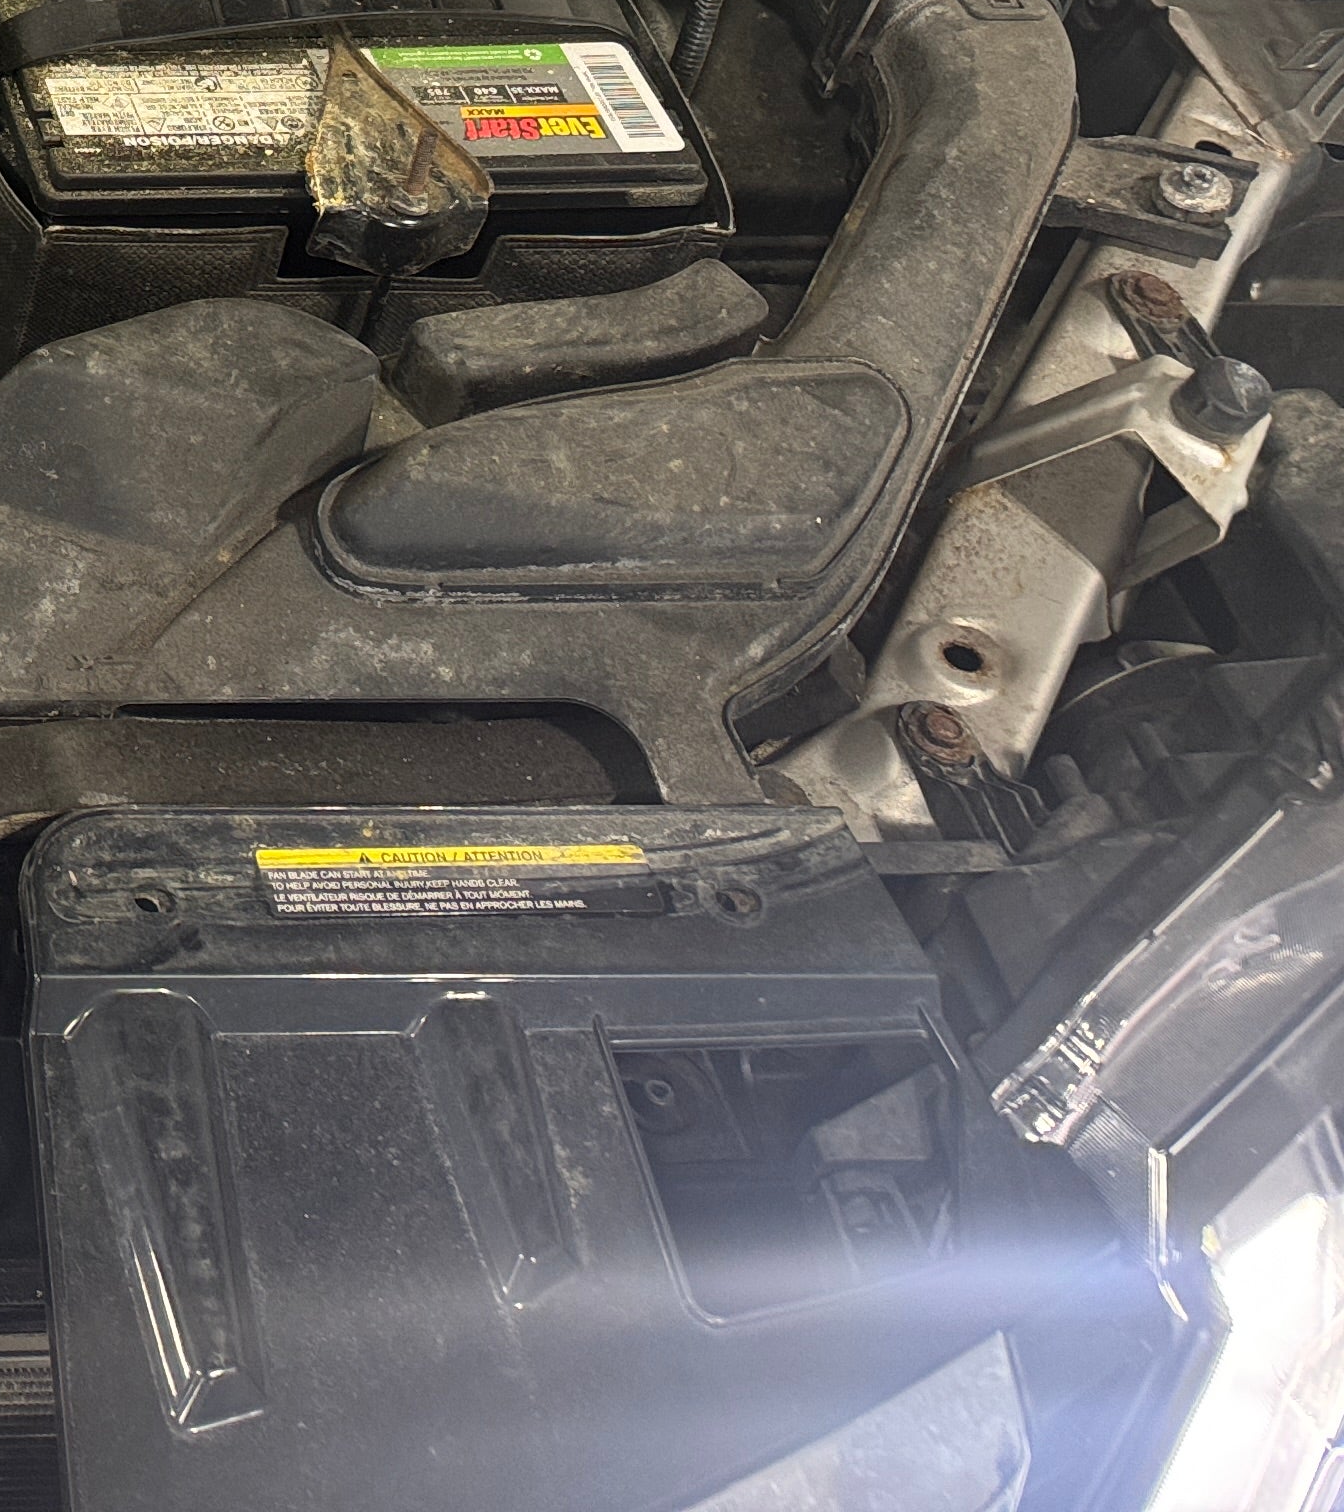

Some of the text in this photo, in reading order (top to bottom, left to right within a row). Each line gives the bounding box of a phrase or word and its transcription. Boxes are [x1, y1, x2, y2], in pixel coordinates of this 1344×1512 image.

[473, 87, 498, 96] 640
[466, 108, 505, 116] MAXX
[464, 115, 607, 141] EverStart
[123, 134, 274, 147] DANGER/POISON
[381, 851, 448, 863] CAUTION
[464, 850, 545, 862] ATTENTION
[268, 871, 287, 880] FAN
[288, 871, 319, 880] BLADE
[320, 871, 341, 879] CAN
[342, 871, 371, 879] START
[271, 882, 284, 890] TO
[286, 882, 311, 890] HELP
[342, 881, 393, 889] PERSONAL
[273, 894, 287, 902] LE
[287, 893, 349, 902] VENTILATEUR
[349, 892, 385, 901] RISQUE
[386, 892, 400, 901] DE
[463, 890, 488, 899] TOUT
[276, 904, 306, 913] POUR
[306, 901, 340, 912] ÉVITER
[340, 903, 371, 912] TOUTE
[425, 902, 439, 911] NE
[439, 901, 459, 910] PAS
[460, 901, 474, 910] EN
[475, 900, 534, 910] APPROCHER
[535, 900, 553, 909] LES
